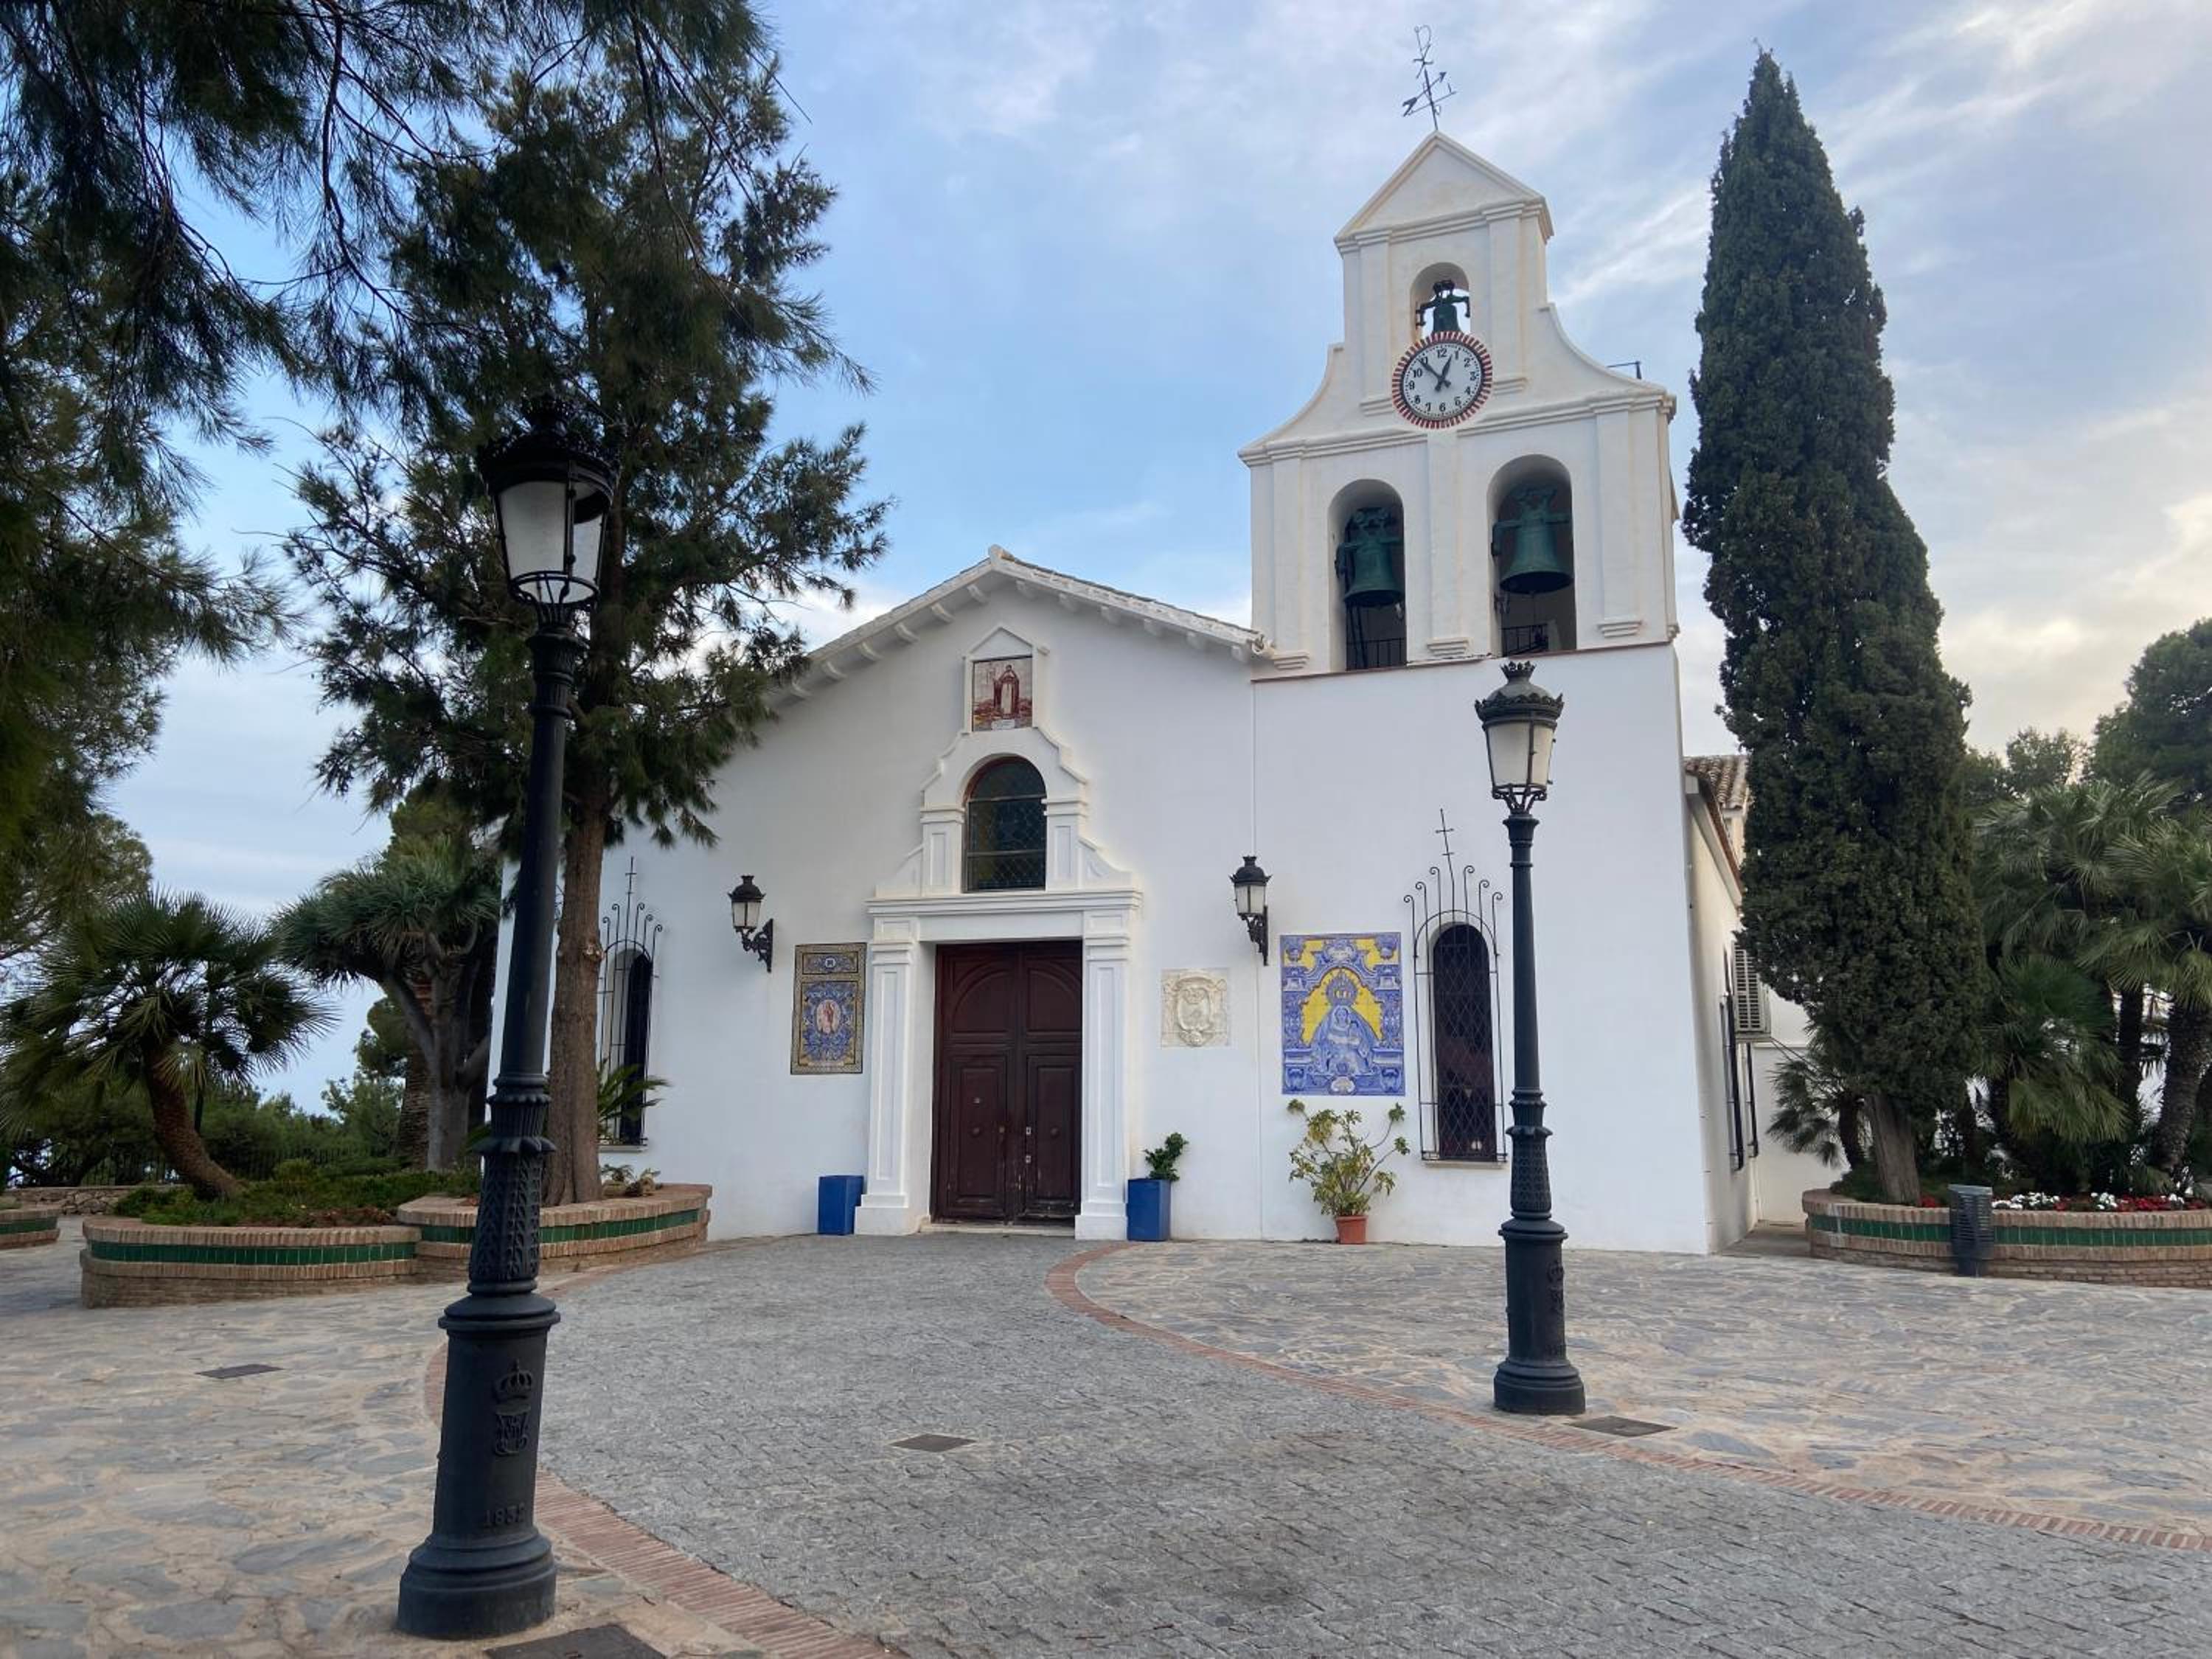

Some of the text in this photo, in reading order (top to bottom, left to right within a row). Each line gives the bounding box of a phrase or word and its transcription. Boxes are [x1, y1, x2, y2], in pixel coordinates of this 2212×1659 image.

[1436, 348, 1447, 358] 12
[1454, 350, 1459, 360] 1
[1464, 358, 1471, 367] 2
[1413, 369, 1422, 378] 10
[1470, 371, 1476, 380] 3
[1408, 380, 1415, 389] 9
[1464, 386, 1470, 394] 4
[1414, 395, 1421, 404] 8
[1454, 396, 1461, 406] 5
[1425, 402, 1430, 411] 7
[1439, 402, 1446, 411] 6
